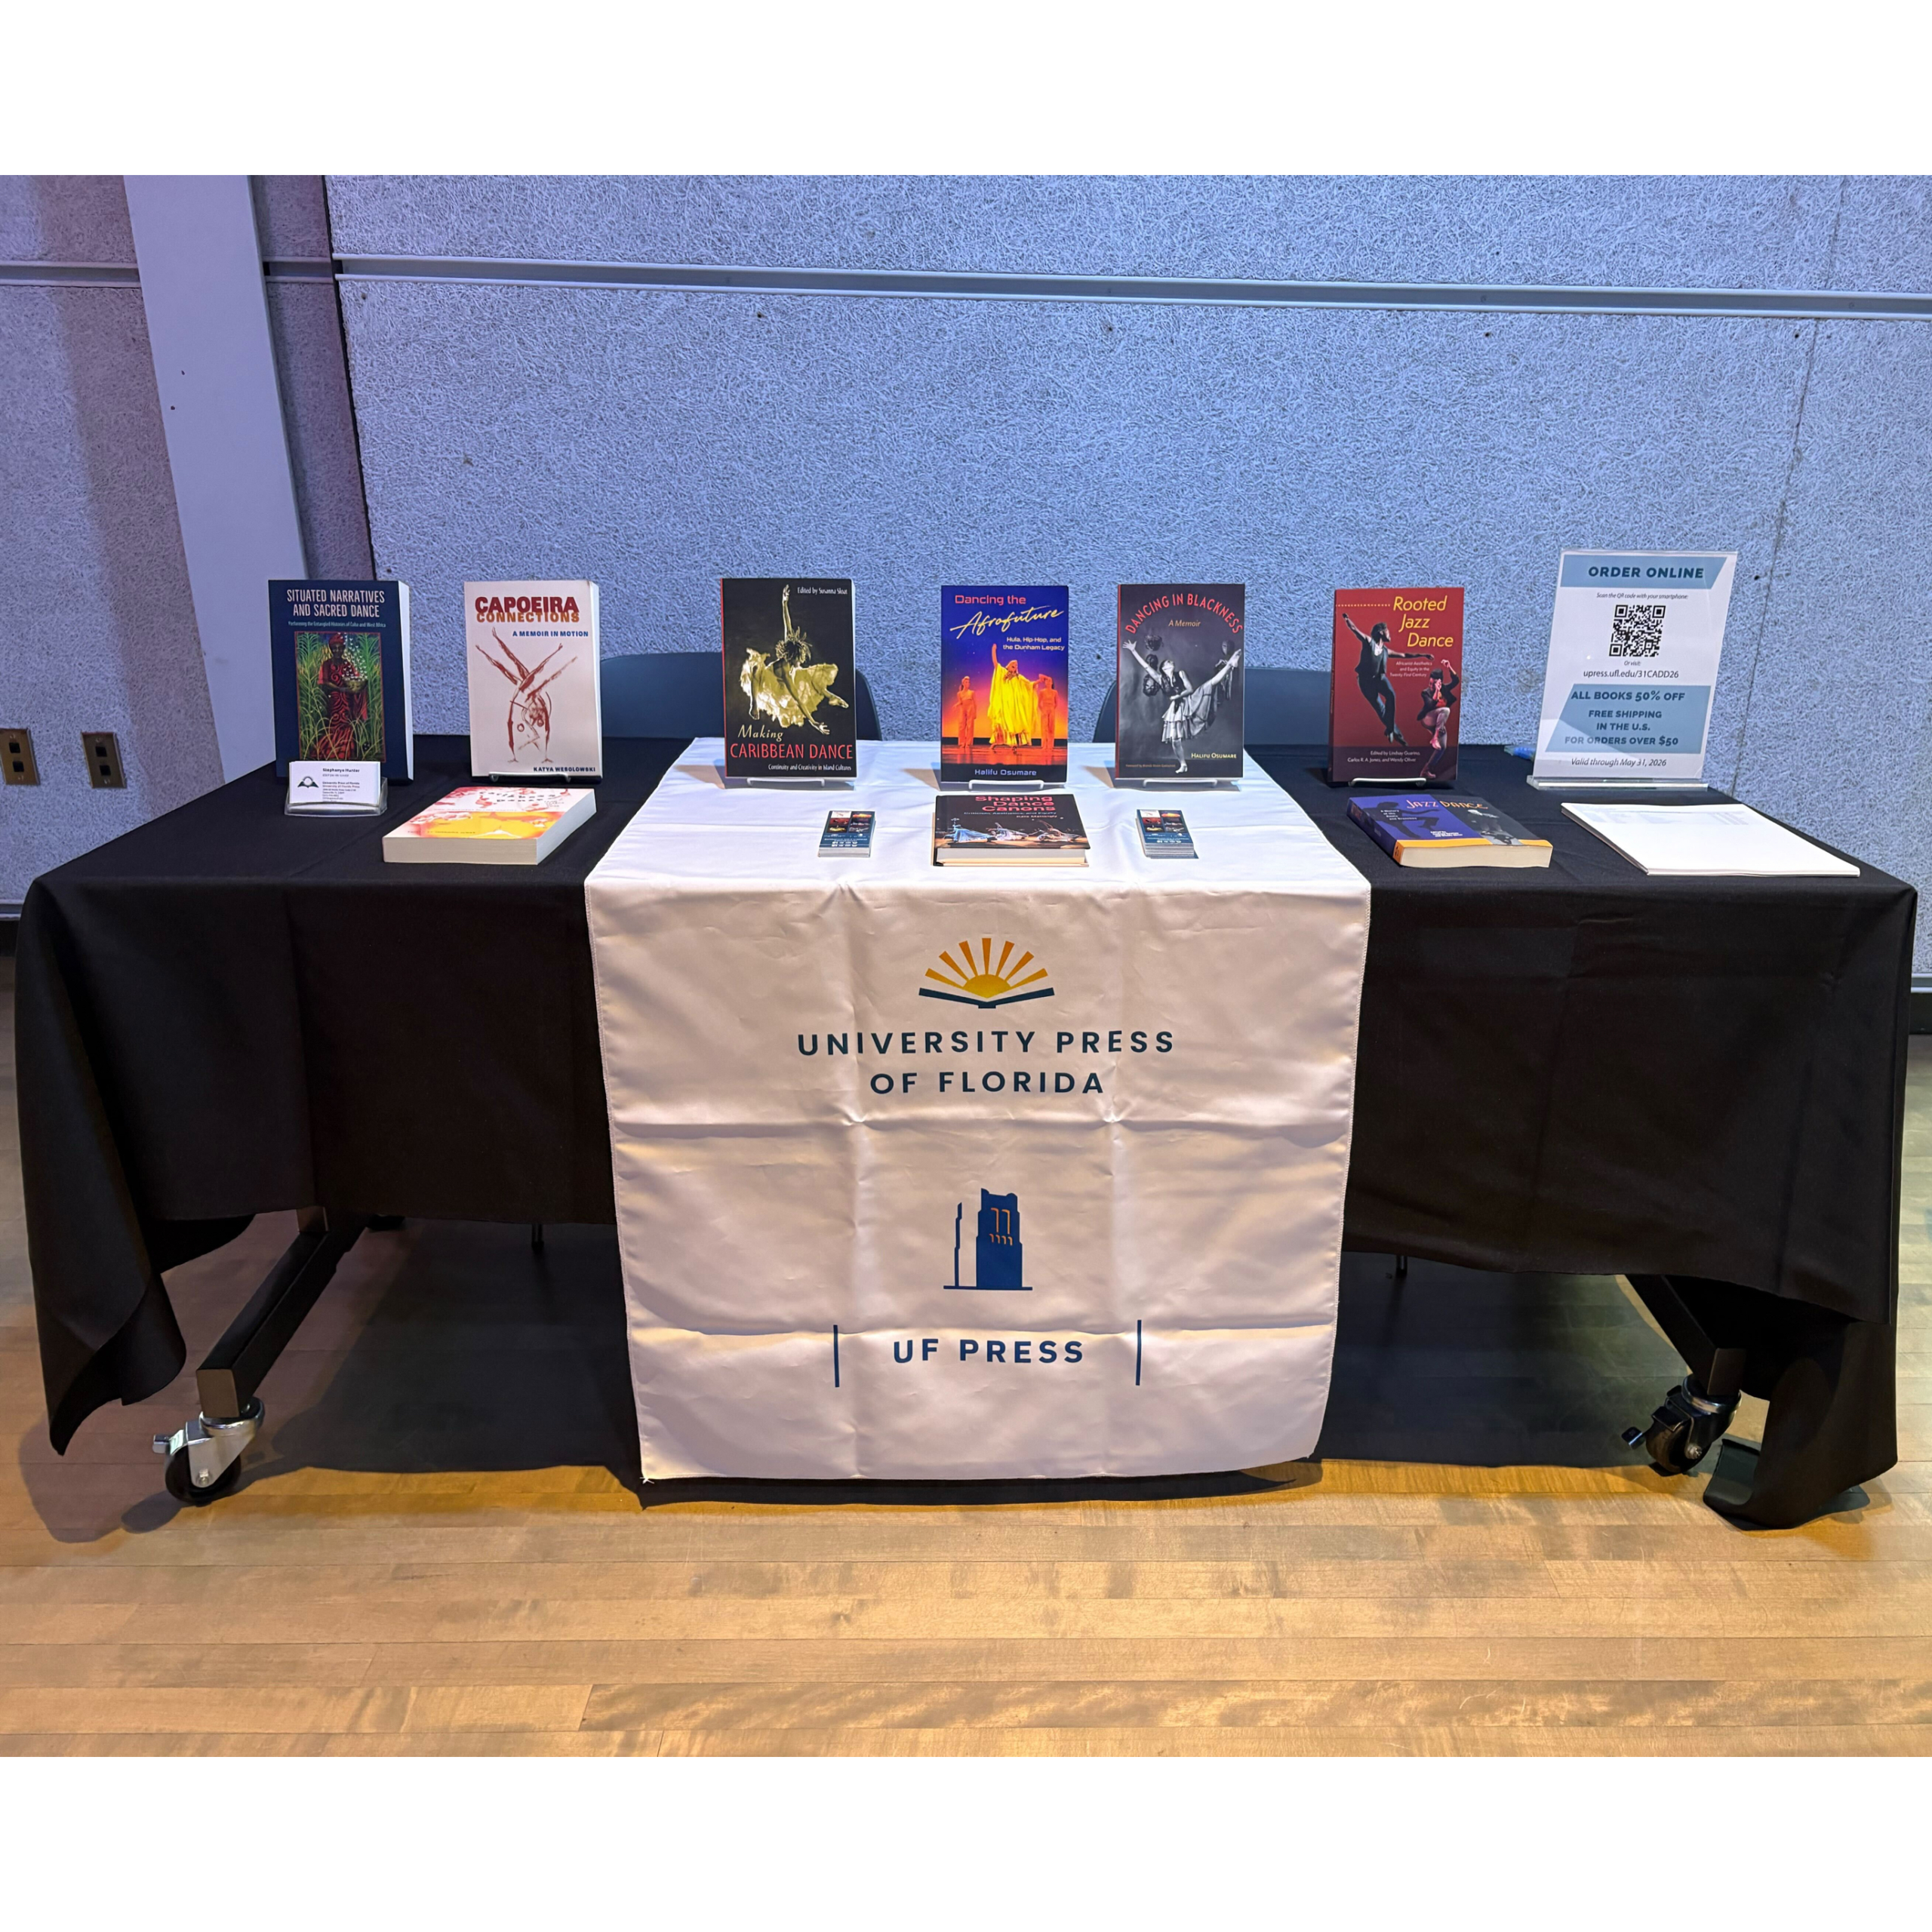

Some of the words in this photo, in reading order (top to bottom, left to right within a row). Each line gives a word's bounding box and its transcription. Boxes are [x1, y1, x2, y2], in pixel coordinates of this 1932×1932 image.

[1589, 567, 1641, 577] ORDER
[1646, 568, 1703, 578] ONLINE
[287, 589, 327, 601] SITUATED
[330, 589, 384, 603] NARRATIVES
[955, 595, 1004, 605] Dancing
[1008, 595, 1026, 604] the
[1393, 595, 1447, 611] Rooted
[294, 604, 310, 616] AND
[314, 604, 347, 617] SACRED
[351, 605, 380, 617] DANCE
[475, 596, 579, 613] CAPOEIRA
[477, 612, 580, 623] CONNECTIONS
[1125, 595, 1169, 634] DANCING
[1172, 593, 1183, 605] IN
[1187, 593, 1243, 633] BLACKNESS
[950, 605, 1064, 639] Afrofuture
[1398, 614, 1430, 632] Jazz
[1407, 632, 1454, 647] Dance
[1571, 691, 1591, 700] ALL
[1594, 691, 1632, 700] BOOKS
[1635, 691, 1660, 702] 50%
[738, 724, 783, 742] Making
[1659, 735, 1678, 746] $50
[730, 743, 804, 758] CARIBBEAN
[810, 744, 853, 758] DANCE
[1590, 758, 1618, 767] through
[1620, 758, 1635, 768] May
[798, 1030, 1036, 1056] UNIVERSITY
[1057, 1030, 1174, 1053] PRESS
[870, 1072, 917, 1094] OF
[939, 1071, 1103, 1094] FLORIDA
[894, 1338, 939, 1364] UF
[960, 1339, 1084, 1363] PRESS
